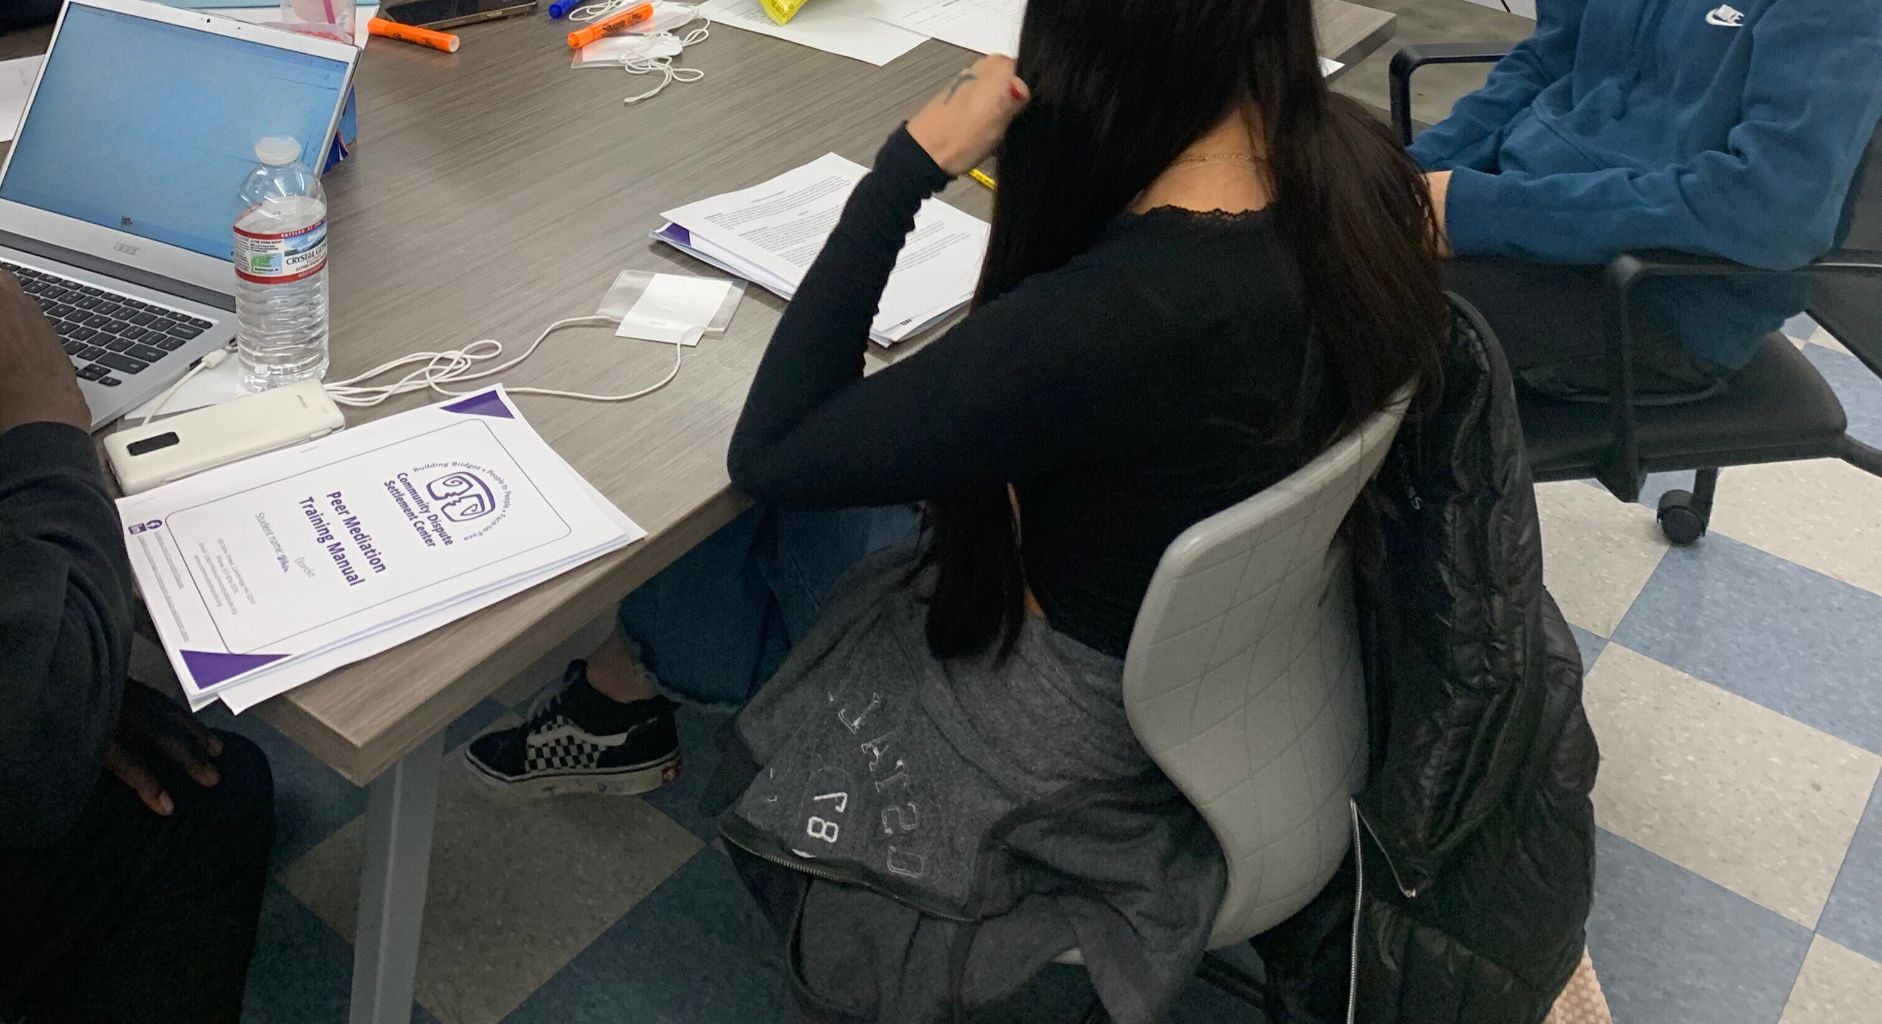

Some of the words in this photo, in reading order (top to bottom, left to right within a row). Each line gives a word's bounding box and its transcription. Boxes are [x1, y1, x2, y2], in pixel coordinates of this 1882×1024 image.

[286, 250, 315, 265] CRYSTAL
[299, 495, 334, 544] Training
[326, 541, 366, 587] Manual
[326, 490, 351, 516] Peer
[342, 515, 387, 574] Mediation
[383, 479, 419, 522] Settlement
[412, 520, 437, 548] Center
[396, 471, 432, 514] Community
[426, 513, 454, 546] Dispute
